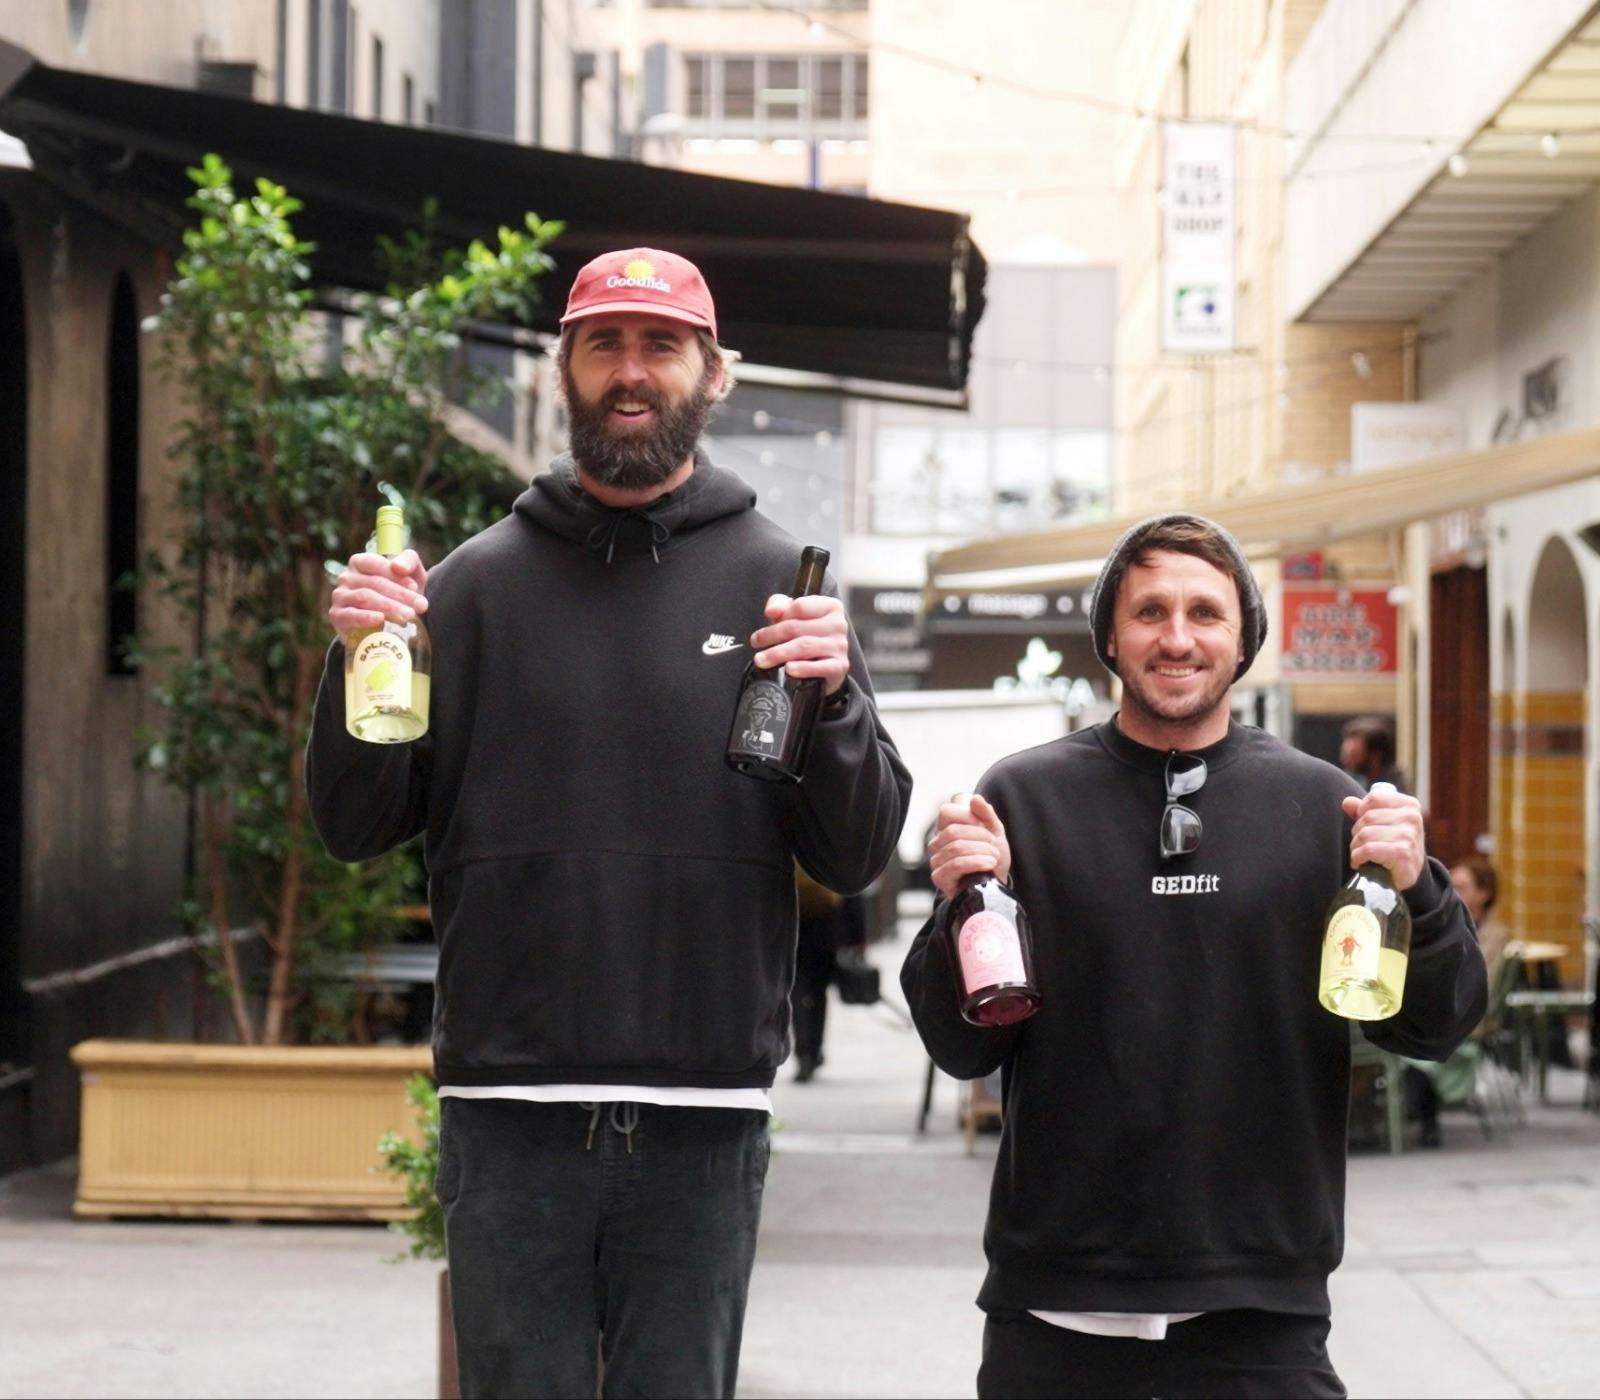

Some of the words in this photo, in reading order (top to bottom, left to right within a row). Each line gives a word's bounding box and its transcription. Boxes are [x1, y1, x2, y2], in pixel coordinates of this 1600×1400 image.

[708, 633, 736, 647] NIKE
[1293, 626, 1380, 648] MAP
[360, 641, 404, 662] SPLICED
[1287, 650, 1383, 671] SHOP
[1151, 873, 1220, 895] GEDfit
